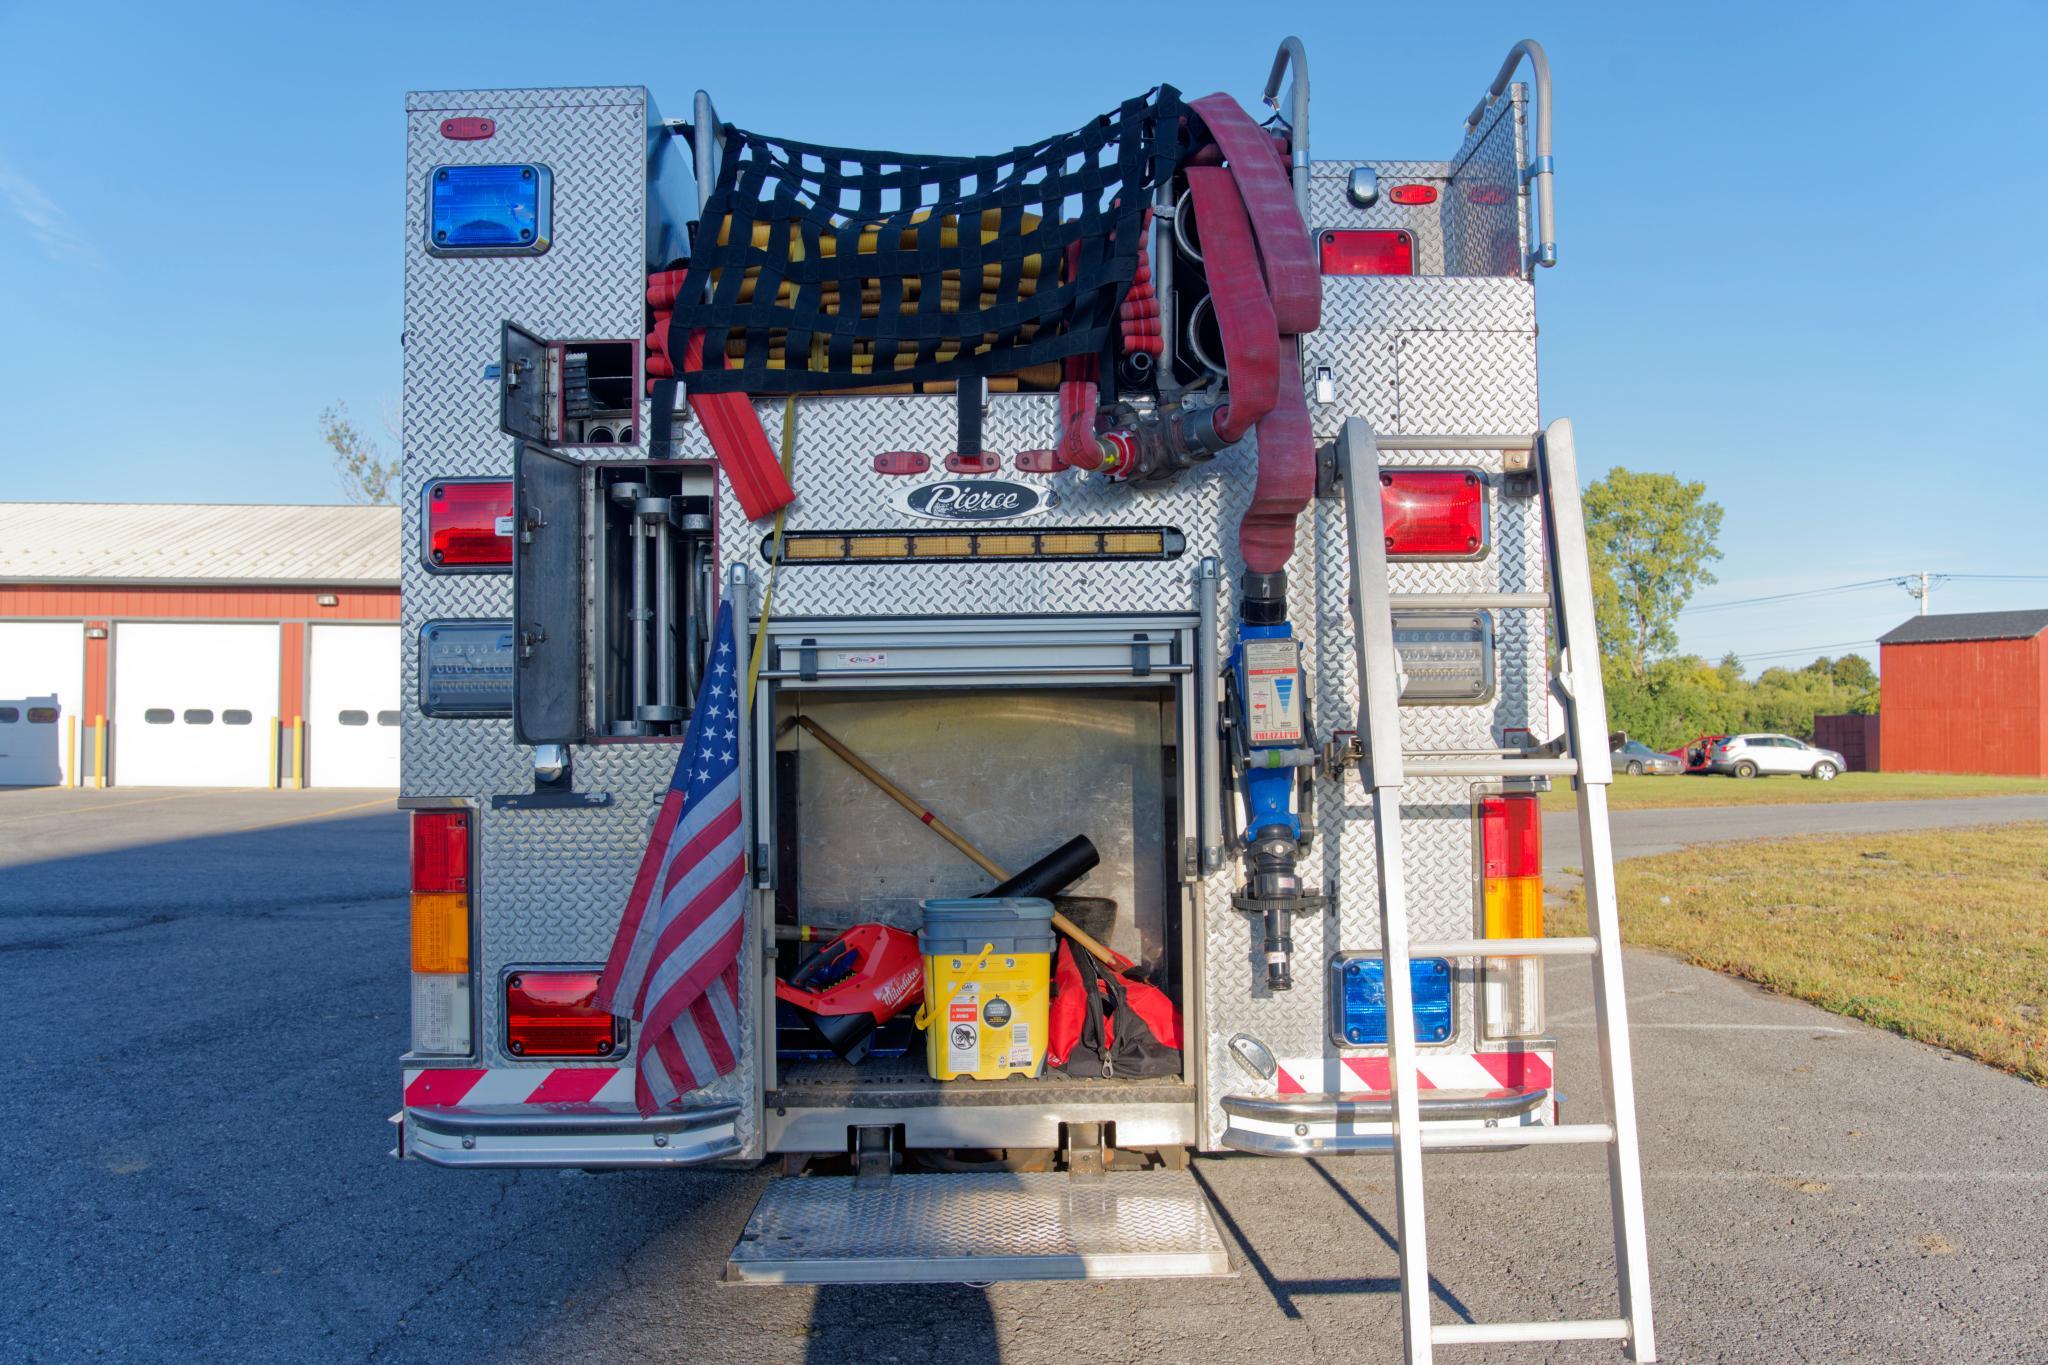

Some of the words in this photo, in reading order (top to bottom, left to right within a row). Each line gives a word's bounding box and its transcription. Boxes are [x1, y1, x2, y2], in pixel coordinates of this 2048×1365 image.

[925, 484, 1020, 514] Pierce
[1254, 731, 1299, 740] BLITZFIRE
[881, 968, 919, 1006] Milwaukee
